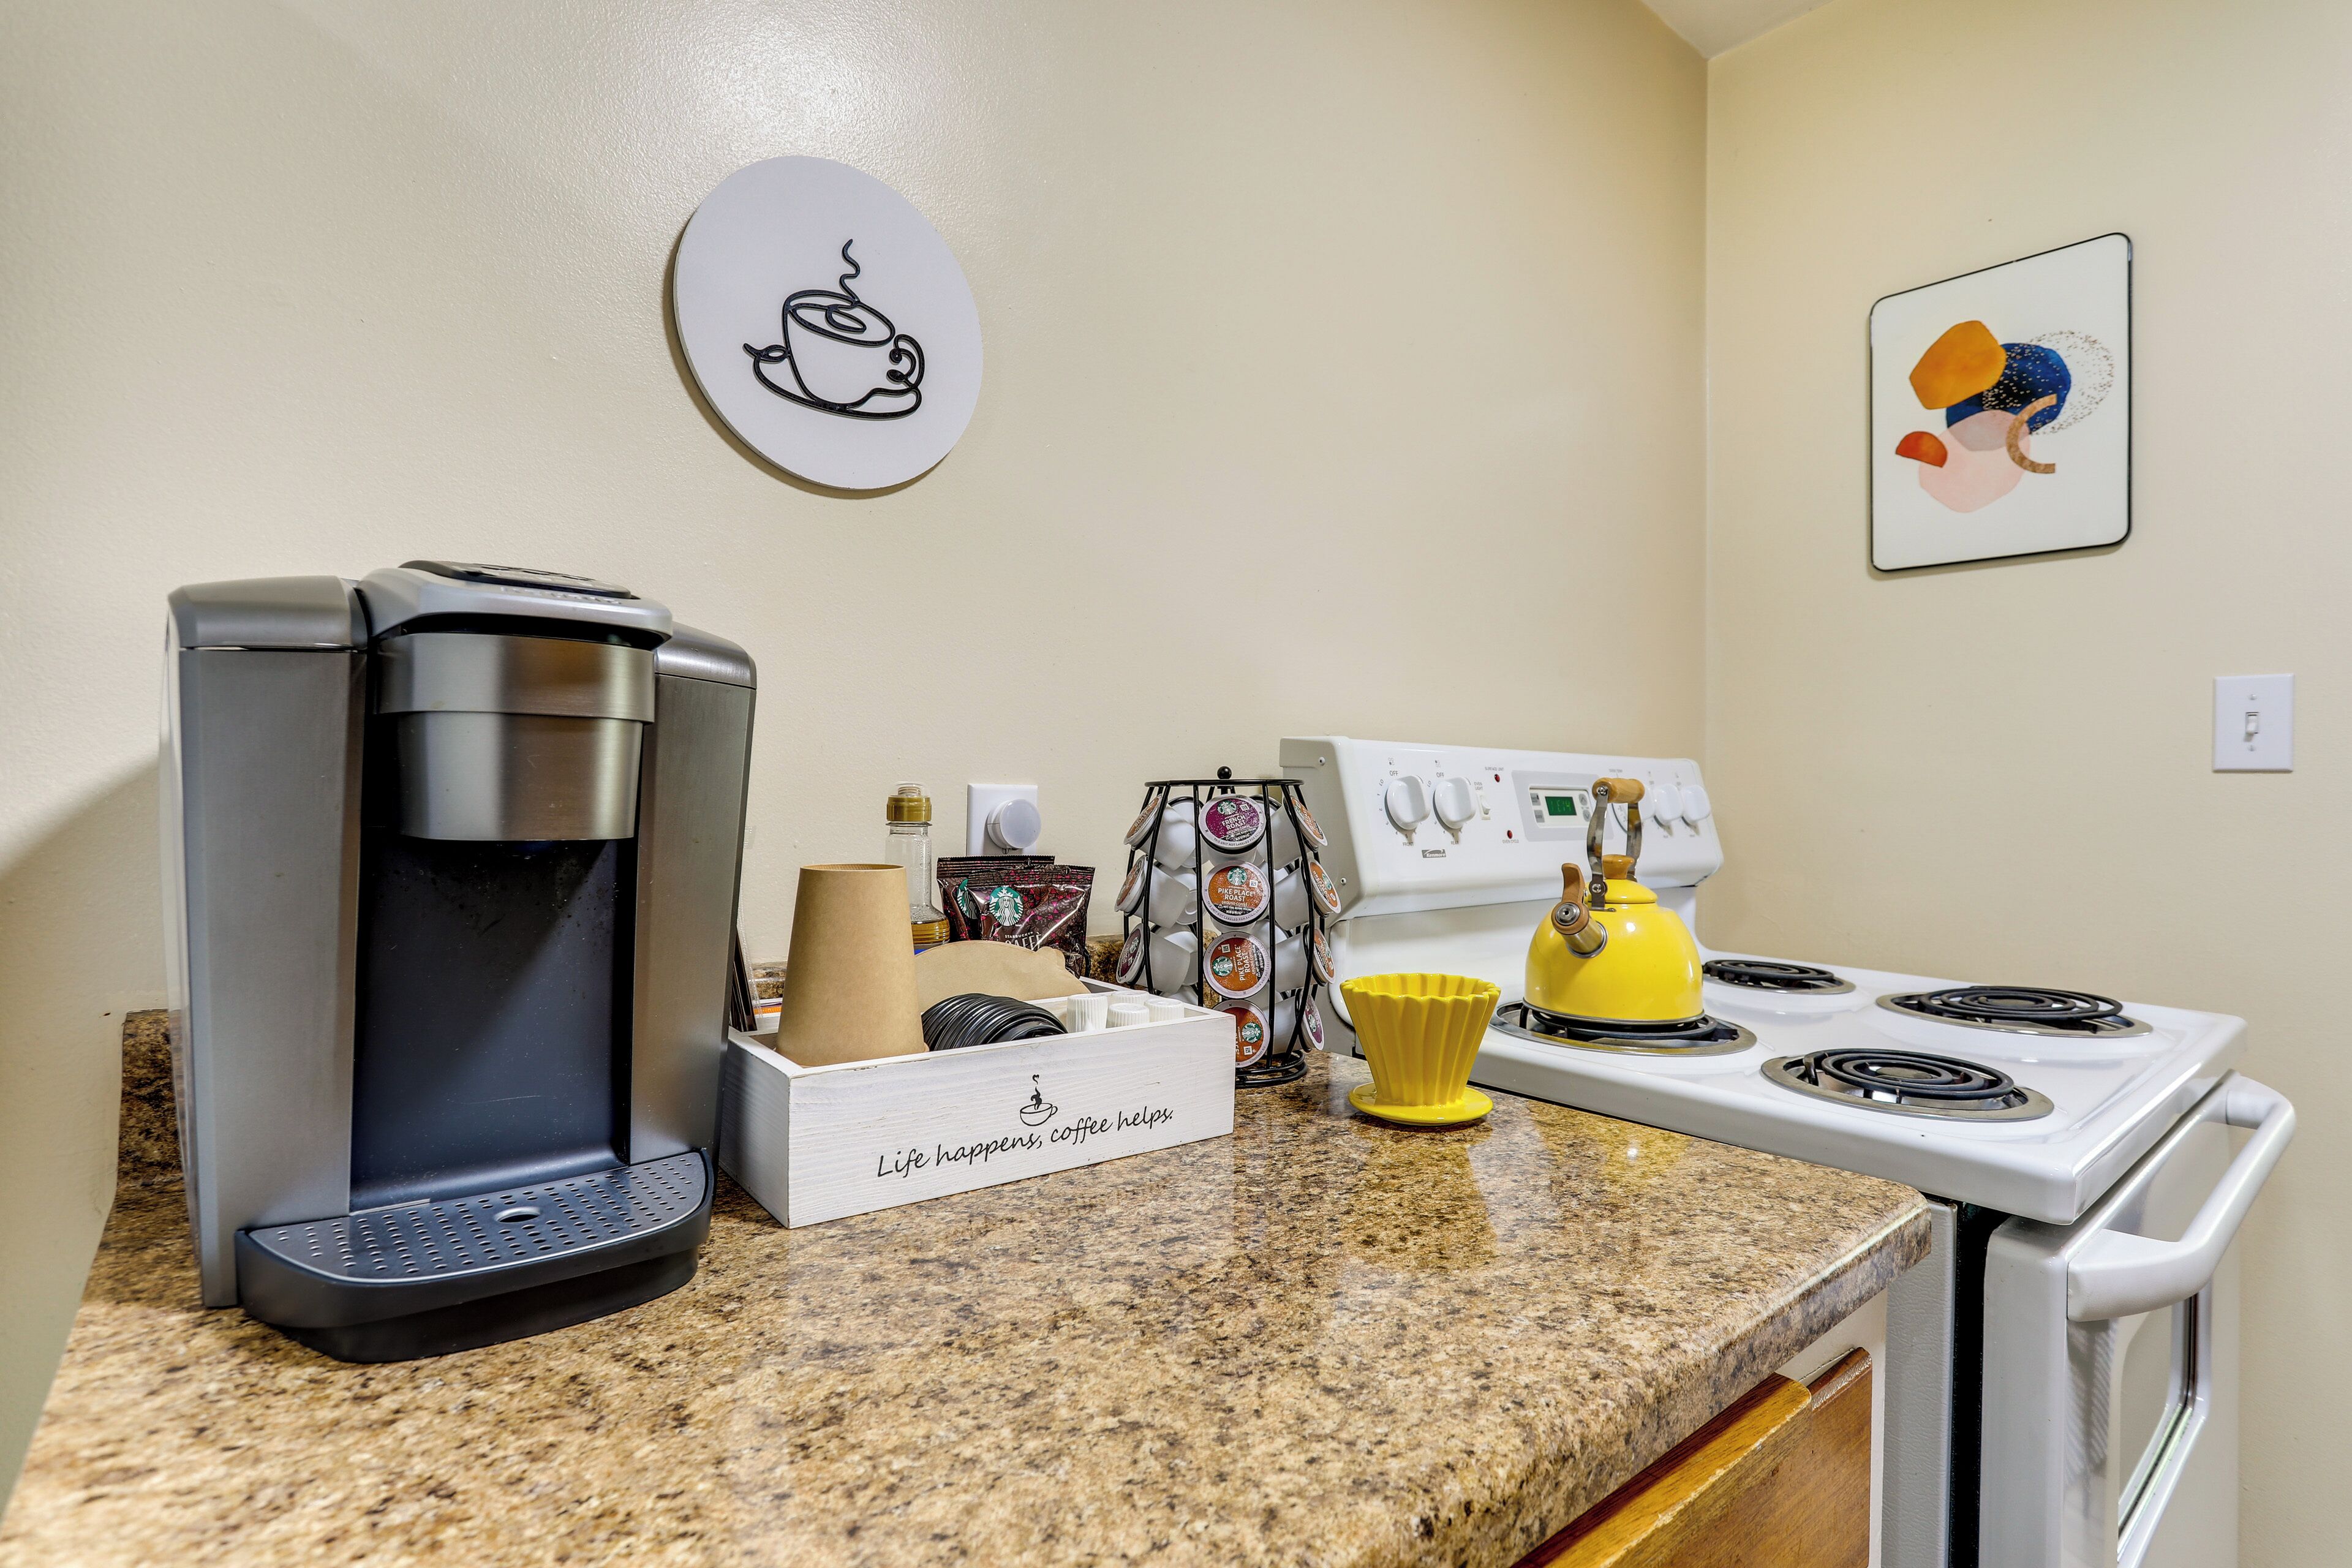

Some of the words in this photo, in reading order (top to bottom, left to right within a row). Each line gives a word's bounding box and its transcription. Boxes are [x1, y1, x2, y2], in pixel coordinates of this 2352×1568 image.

[1221, 815, 1246, 826] FRENCH
[1226, 820, 1246, 830] ROAST
[1005, 932, 1041, 951] FFÈ
[1235, 946, 1243, 968] PLACE
[1242, 952, 1251, 973] ROAST
[877, 1148, 931, 1178] Life
[936, 1133, 1042, 1166] happens,
[1050, 1117, 1113, 1145] coffee
[1117, 1106, 1174, 1131] helps.
